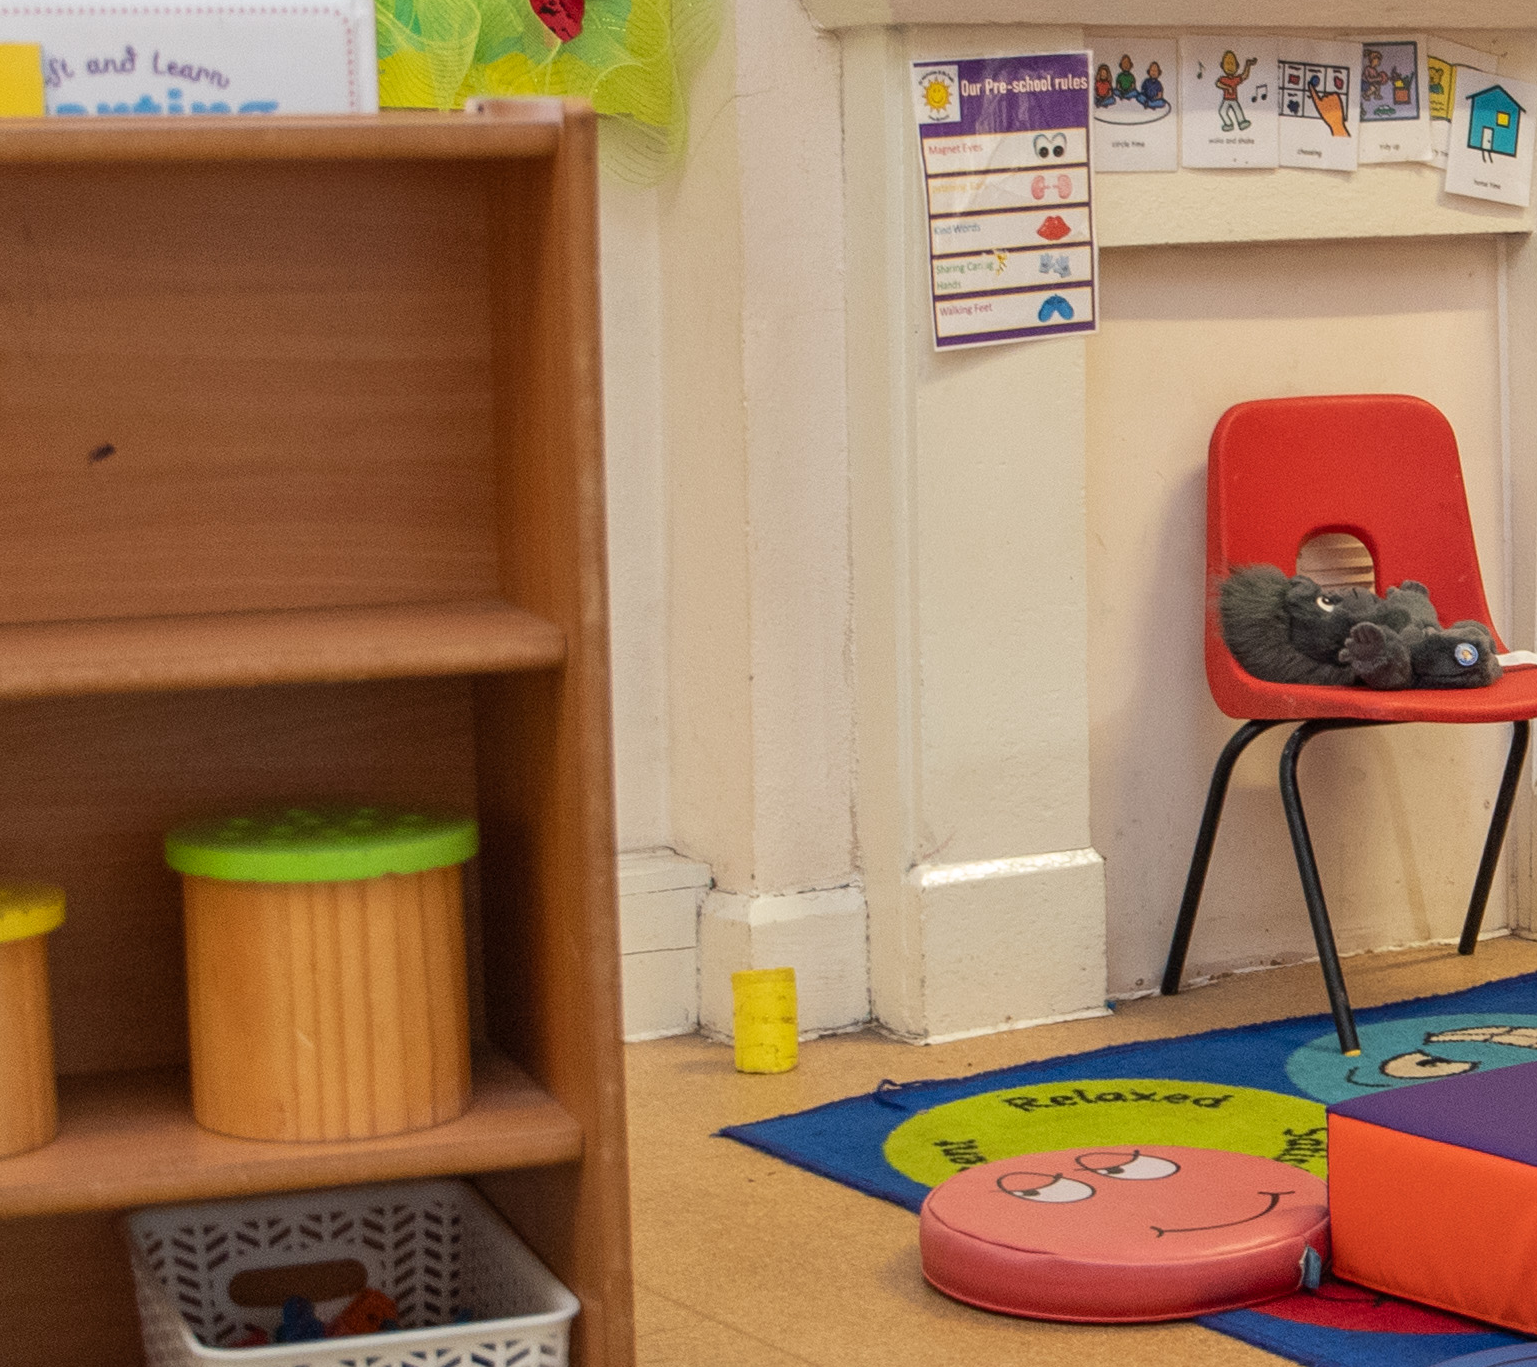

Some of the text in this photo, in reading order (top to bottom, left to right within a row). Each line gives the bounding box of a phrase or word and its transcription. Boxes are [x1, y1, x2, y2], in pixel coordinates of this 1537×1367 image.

[86, 44, 137, 75] and
[152, 50, 230, 90] Learn
[961, 74, 1088, 97] Our Pre-school rules
[928, 145, 960, 156] Magnet
[934, 223, 981, 235] Kind Words
[936, 264, 965, 275] Sharing
[936, 281, 961, 290] Hands
[939, 303, 993, 316] Walking Feet
[1003, 1088, 1235, 1112] Relaxed
